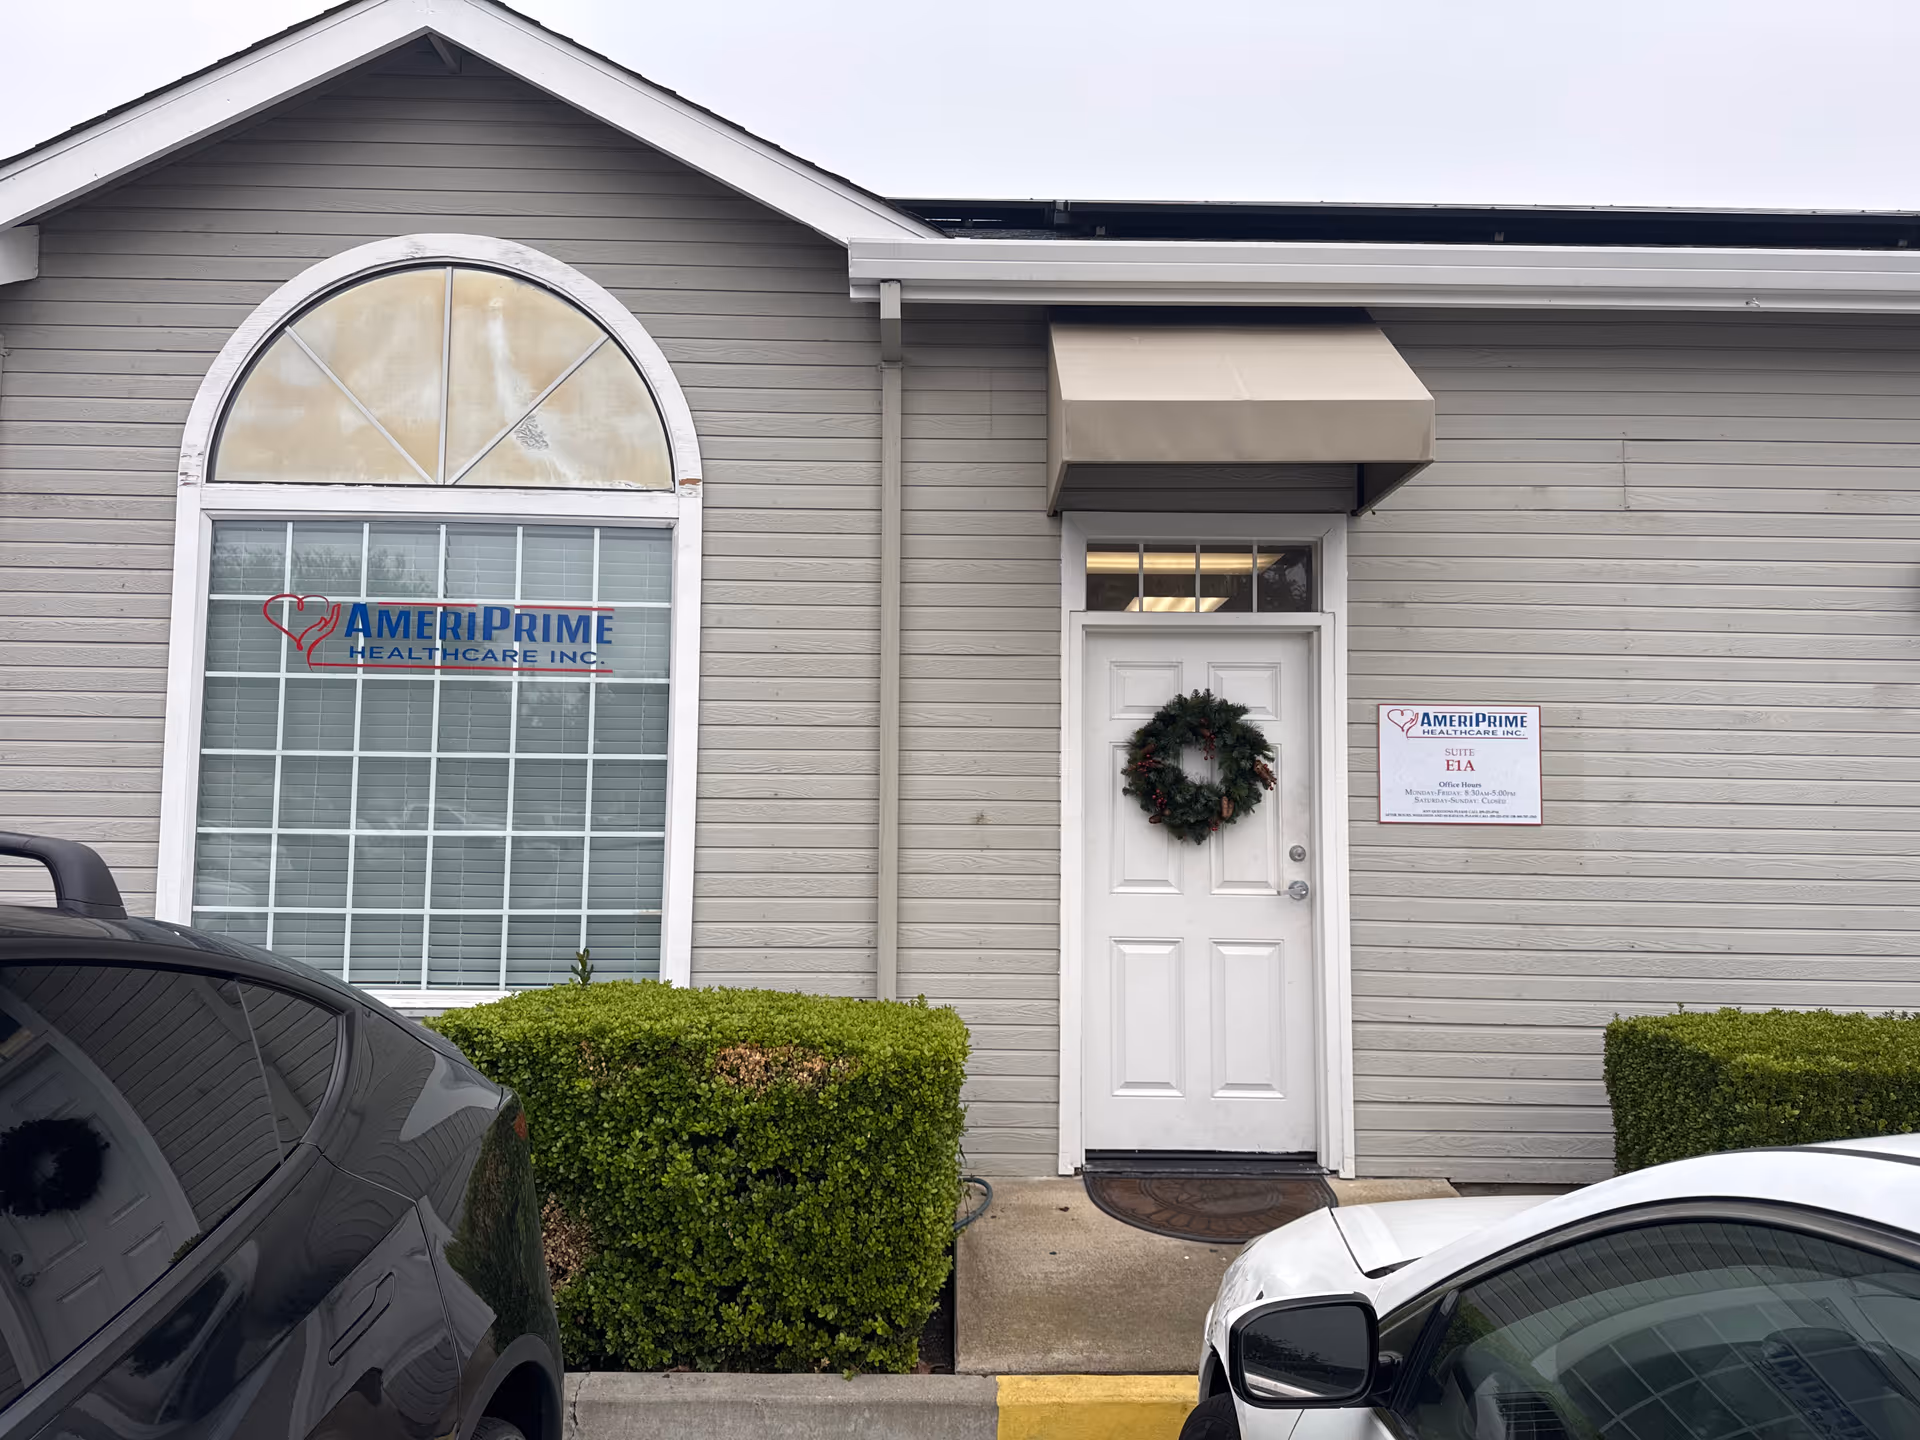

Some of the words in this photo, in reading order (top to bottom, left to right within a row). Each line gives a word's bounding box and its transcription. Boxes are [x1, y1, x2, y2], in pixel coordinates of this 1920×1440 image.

[343, 602, 613, 645] AMERIPRIME
[349, 645, 538, 663] HEALTHCARE
[550, 650, 605, 665] INC.
[1420, 712, 1528, 729] AMERIPRIME
[1445, 748, 1475, 757] SUITE
[1445, 759, 1476, 772] E1A
